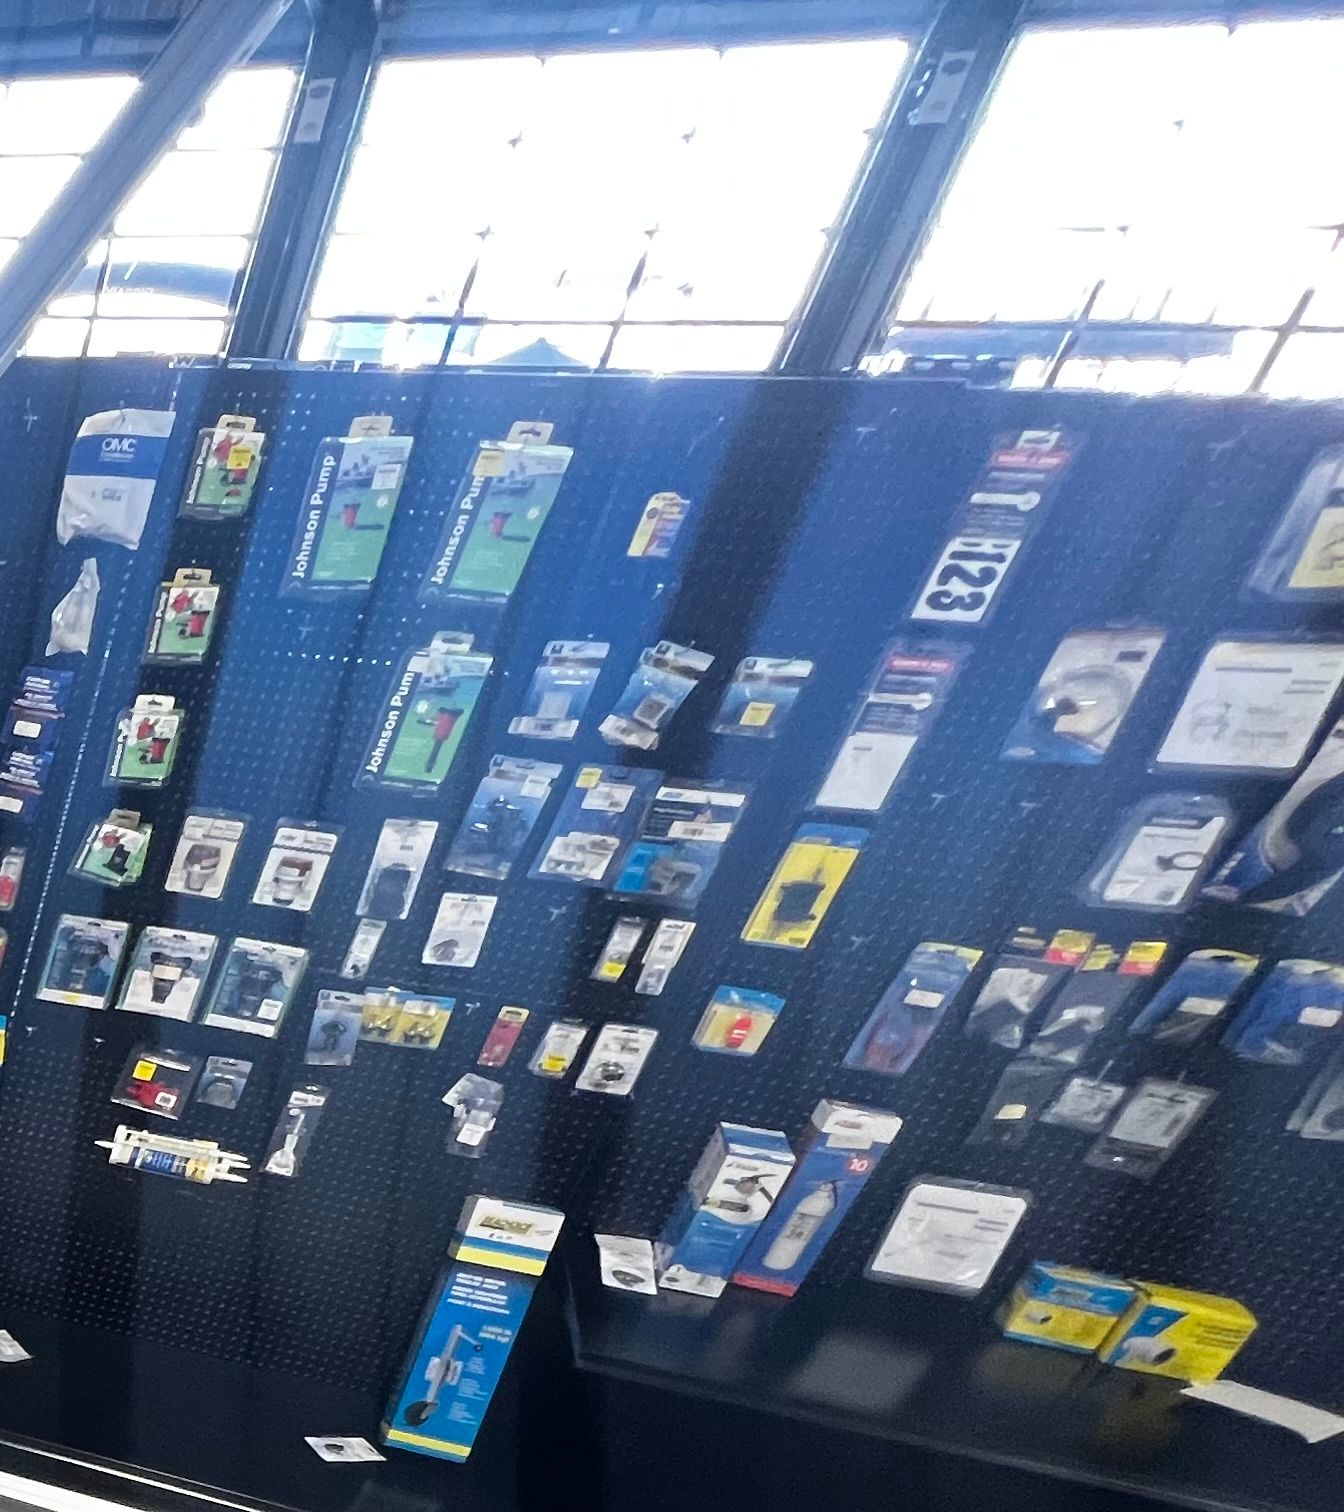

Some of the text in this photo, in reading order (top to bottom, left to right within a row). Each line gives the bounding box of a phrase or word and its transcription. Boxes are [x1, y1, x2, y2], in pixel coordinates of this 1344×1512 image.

[102, 438, 136, 452] OMC
[292, 454, 337, 579] Johnson Pump
[431, 475, 486, 585] Johnson Pum
[365, 671, 415, 773] Johnson Pum
